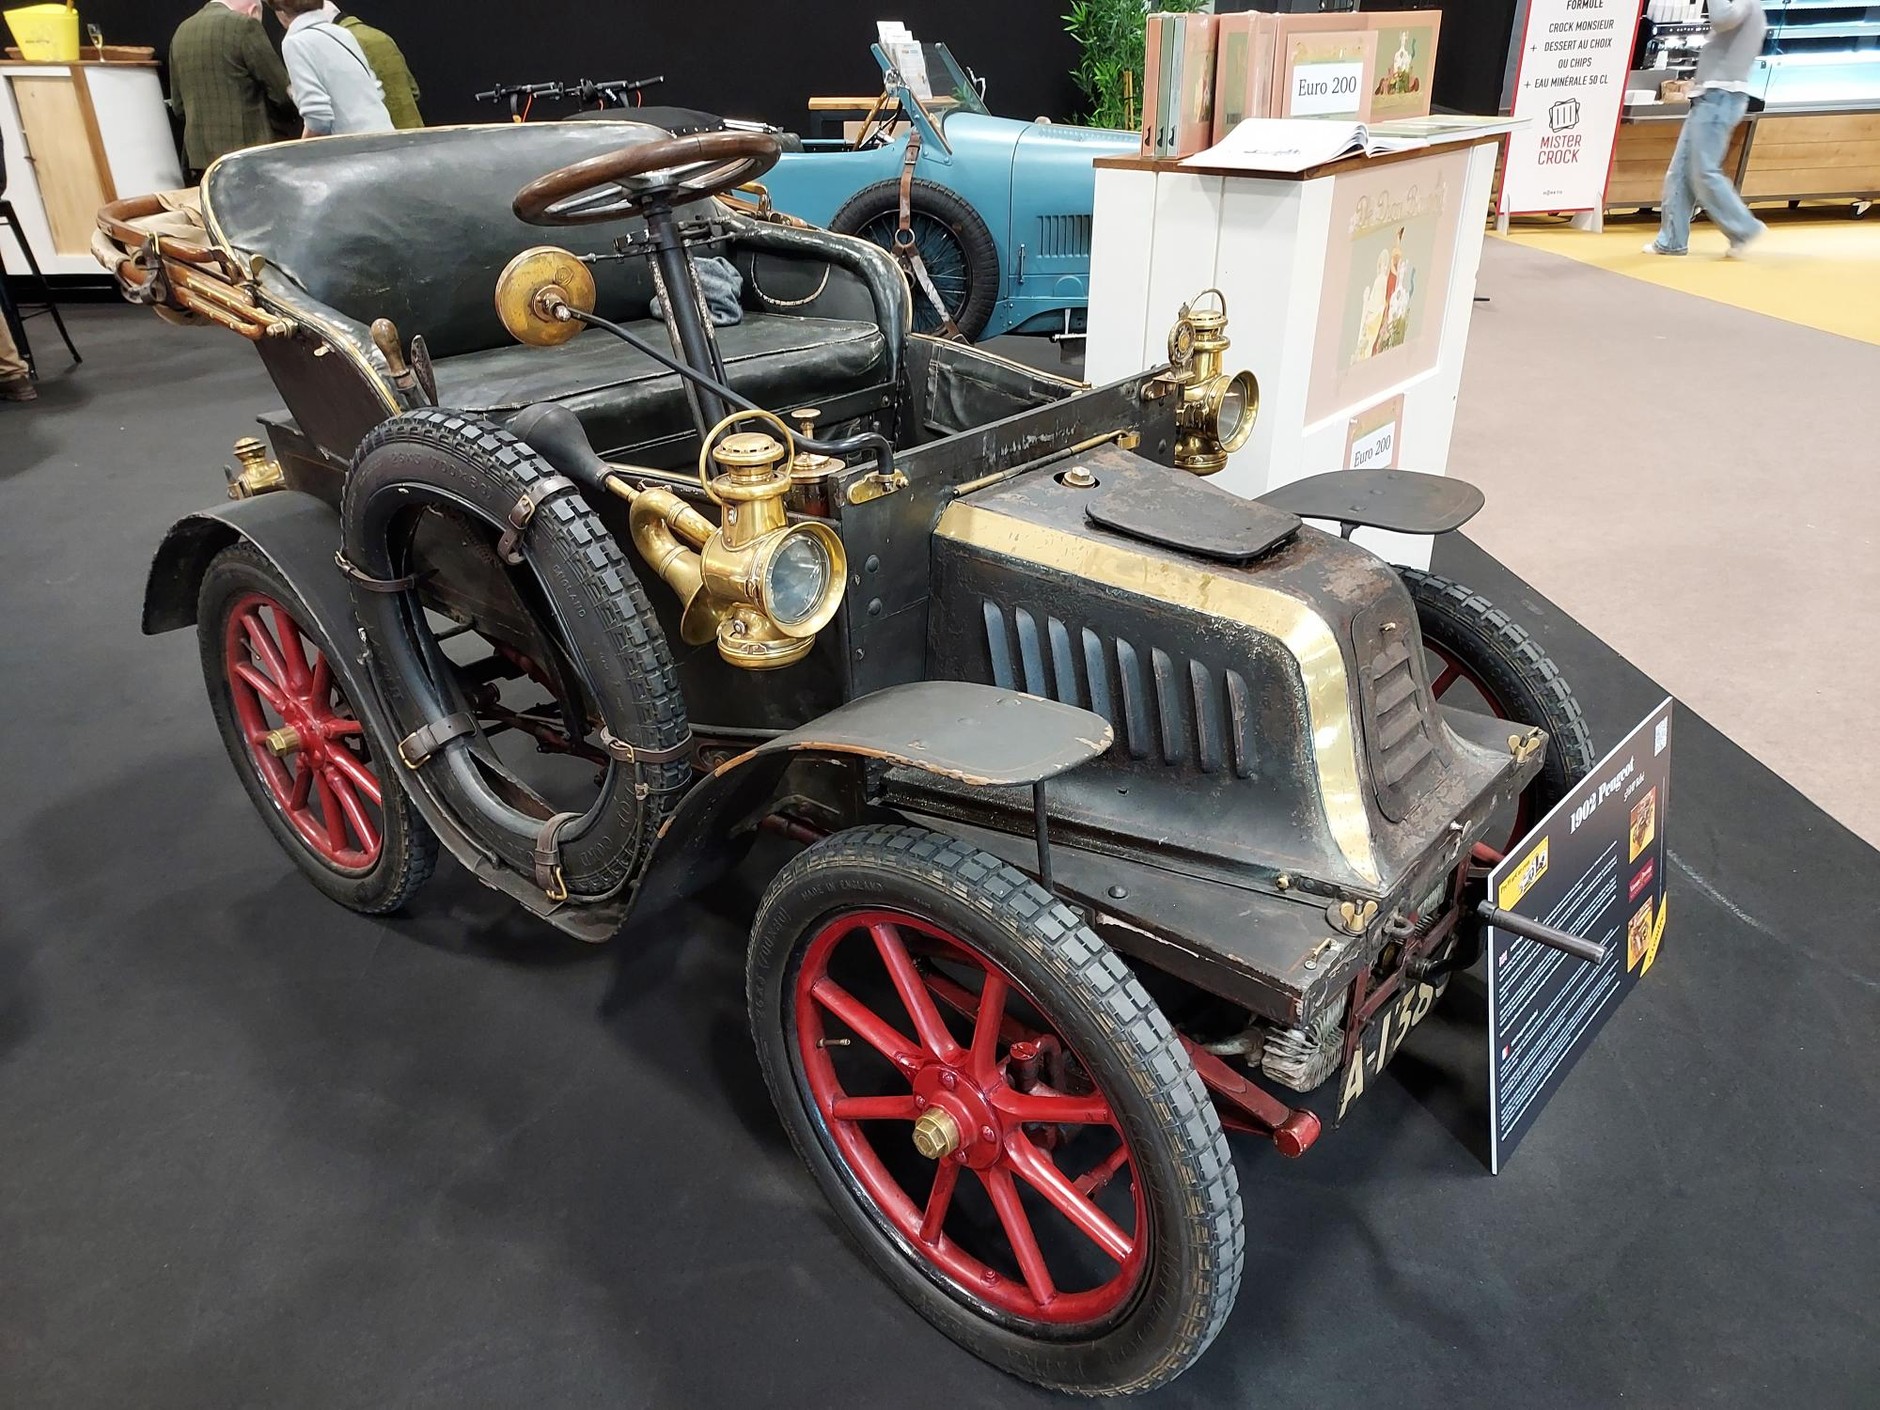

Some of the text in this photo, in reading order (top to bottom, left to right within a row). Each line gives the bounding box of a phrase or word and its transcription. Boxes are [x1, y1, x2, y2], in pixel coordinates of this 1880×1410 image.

[1566, 0, 1604, 10] FORMULE
[1549, 19, 1615, 33] CROCK MONSIEUR
[1544, 40, 1577, 52] DESSERT
[1578, 39, 1589, 50] AU
[1589, 38, 1613, 49] CHOIX
[1558, 57, 1592, 69] OU CHIPS
[1298, 76, 1357, 97] Euro 200
[1534, 78, 1549, 89] EAU
[1550, 75, 1588, 88] MINÉRALE
[1589, 75, 1598, 86] 50
[1599, 74, 1609, 85] CL
[1538, 149, 1580, 165] CROCK
[1354, 434, 1391, 468] Euro 200
[1570, 792, 1597, 835] 1902
[1597, 755, 1635, 806] Peugeot
